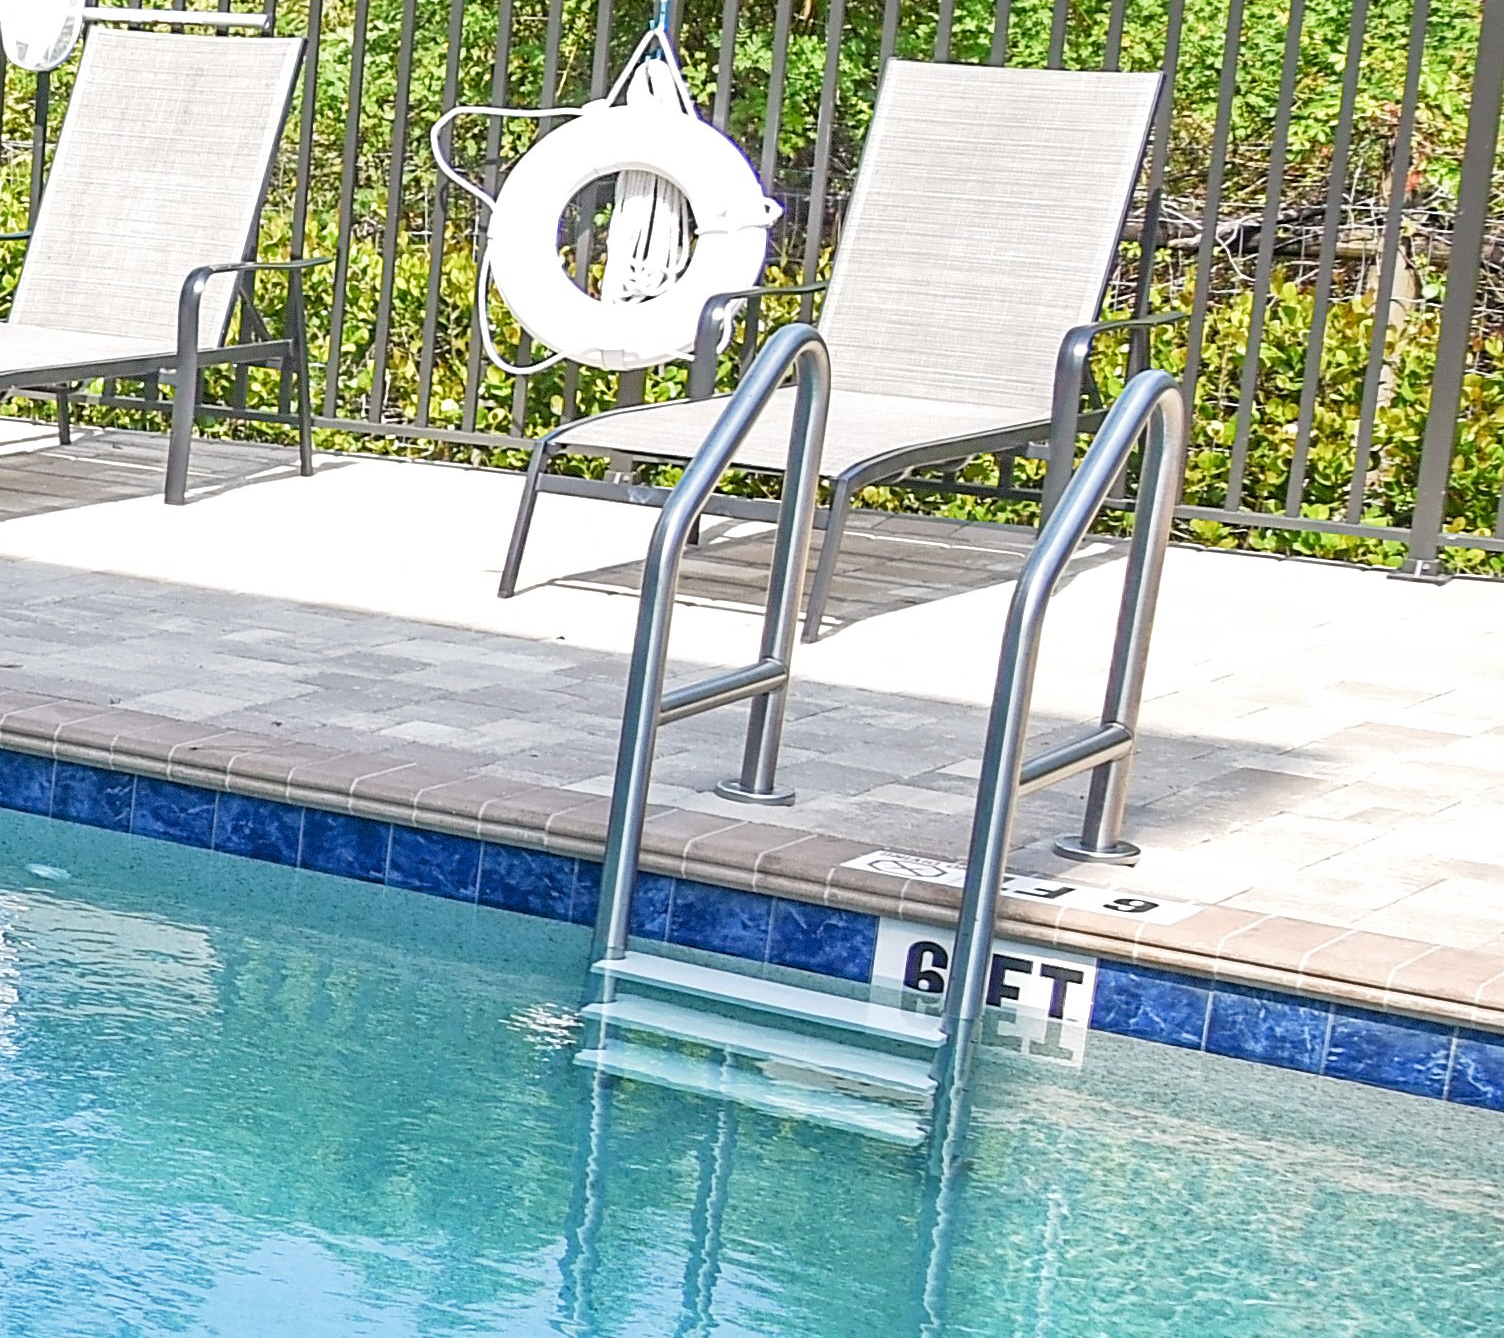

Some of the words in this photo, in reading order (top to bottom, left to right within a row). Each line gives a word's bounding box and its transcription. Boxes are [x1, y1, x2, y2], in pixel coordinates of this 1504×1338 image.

[1102, 898, 1160, 913] 6
[903, 940, 949, 994] 6
[985, 951, 1084, 1020] FT
